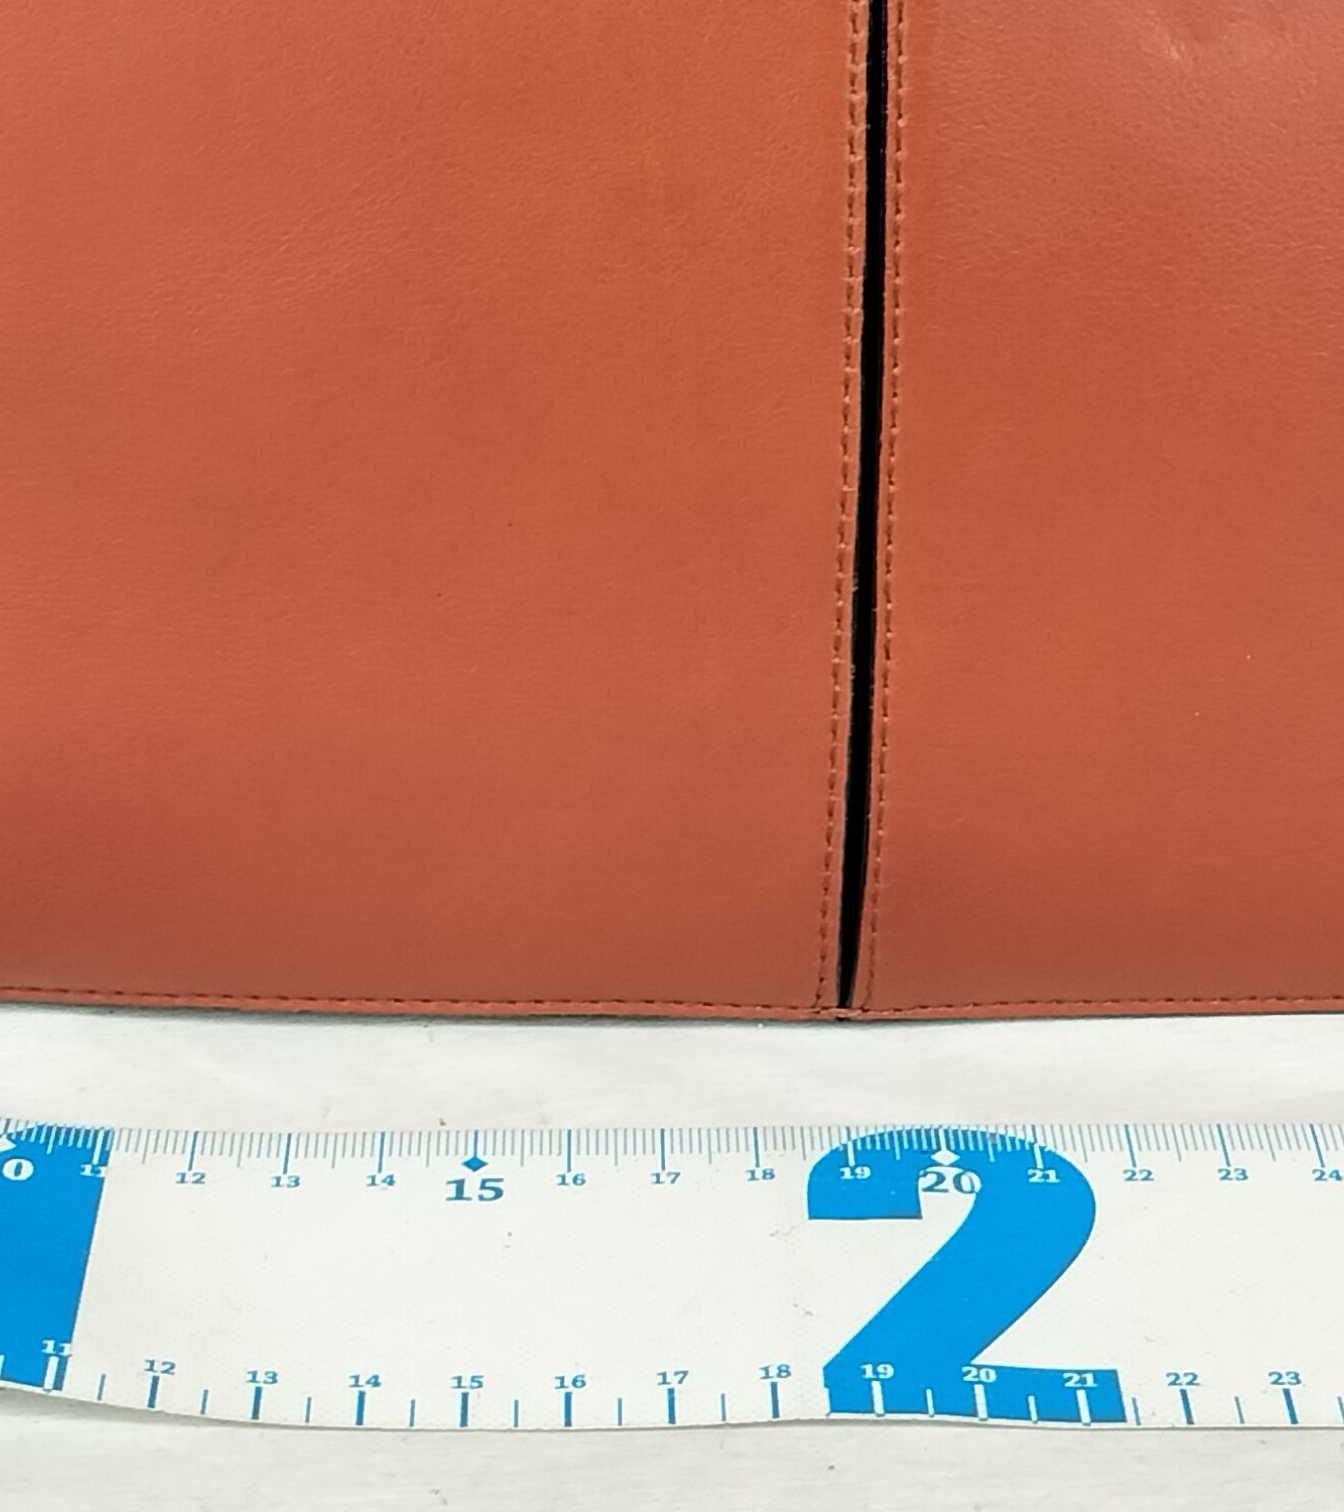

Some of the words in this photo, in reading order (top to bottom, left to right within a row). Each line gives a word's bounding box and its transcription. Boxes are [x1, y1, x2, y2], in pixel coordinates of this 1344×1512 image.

[80, 1164, 106, 1177] 11
[175, 1171, 206, 1185] 12
[271, 1175, 301, 1188] 13
[366, 1174, 396, 1186] 14
[444, 1178, 505, 1202] 15
[556, 1173, 586, 1186] 16
[650, 1171, 681, 1185] 17
[745, 1168, 775, 1181] 18
[839, 1166, 871, 1179] 19
[921, 1170, 981, 1194] 20
[1028, 1169, 1060, 1183] 21
[1123, 1169, 1154, 1182] 22
[1217, 1168, 1248, 1182] 23
[1312, 1169, 1343, 1182] 24
[807, 1128, 1127, 1422] 2
[42, 1340, 71, 1353] 11
[144, 1360, 176, 1375] 12
[246, 1370, 278, 1385] 13
[348, 1374, 381, 1387] 14
[451, 1375, 485, 1388] 15
[554, 1375, 586, 1388] 16
[655, 1371, 689, 1385] 17
[759, 1364, 791, 1380] 18
[861, 1364, 894, 1379] 19
[962, 1366, 996, 1382] 20
[1063, 1373, 1097, 1387] 21
[1166, 1372, 1199, 1386] 22
[1268, 1371, 1302, 1386] 23
